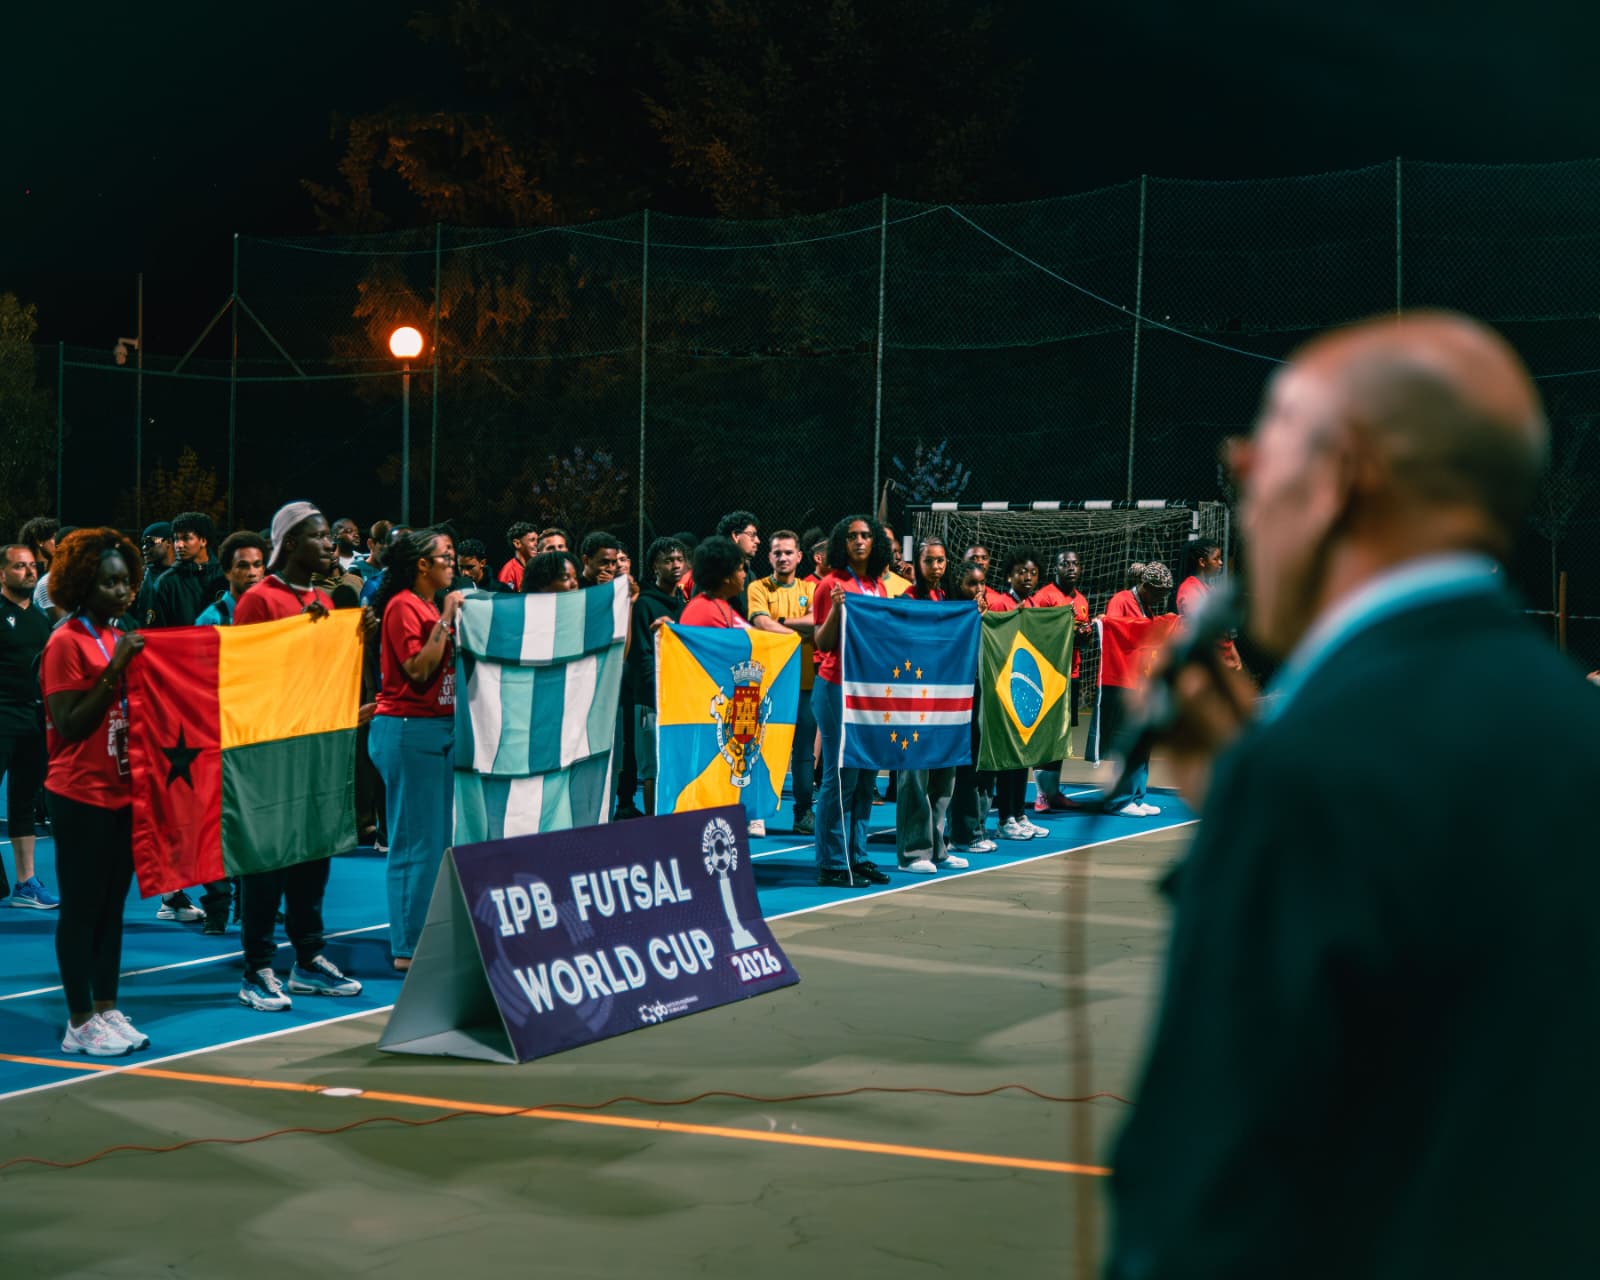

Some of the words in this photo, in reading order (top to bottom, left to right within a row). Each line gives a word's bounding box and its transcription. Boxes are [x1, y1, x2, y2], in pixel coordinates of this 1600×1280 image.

[703, 819, 715, 853] FUTSAL
[714, 816, 736, 845] WORLD
[490, 882, 558, 936] IPB
[570, 858, 692, 921] FUTSAL
[513, 945, 646, 1014] WORLD
[648, 929, 715, 980] CUP
[731, 948, 781, 981] 2026
